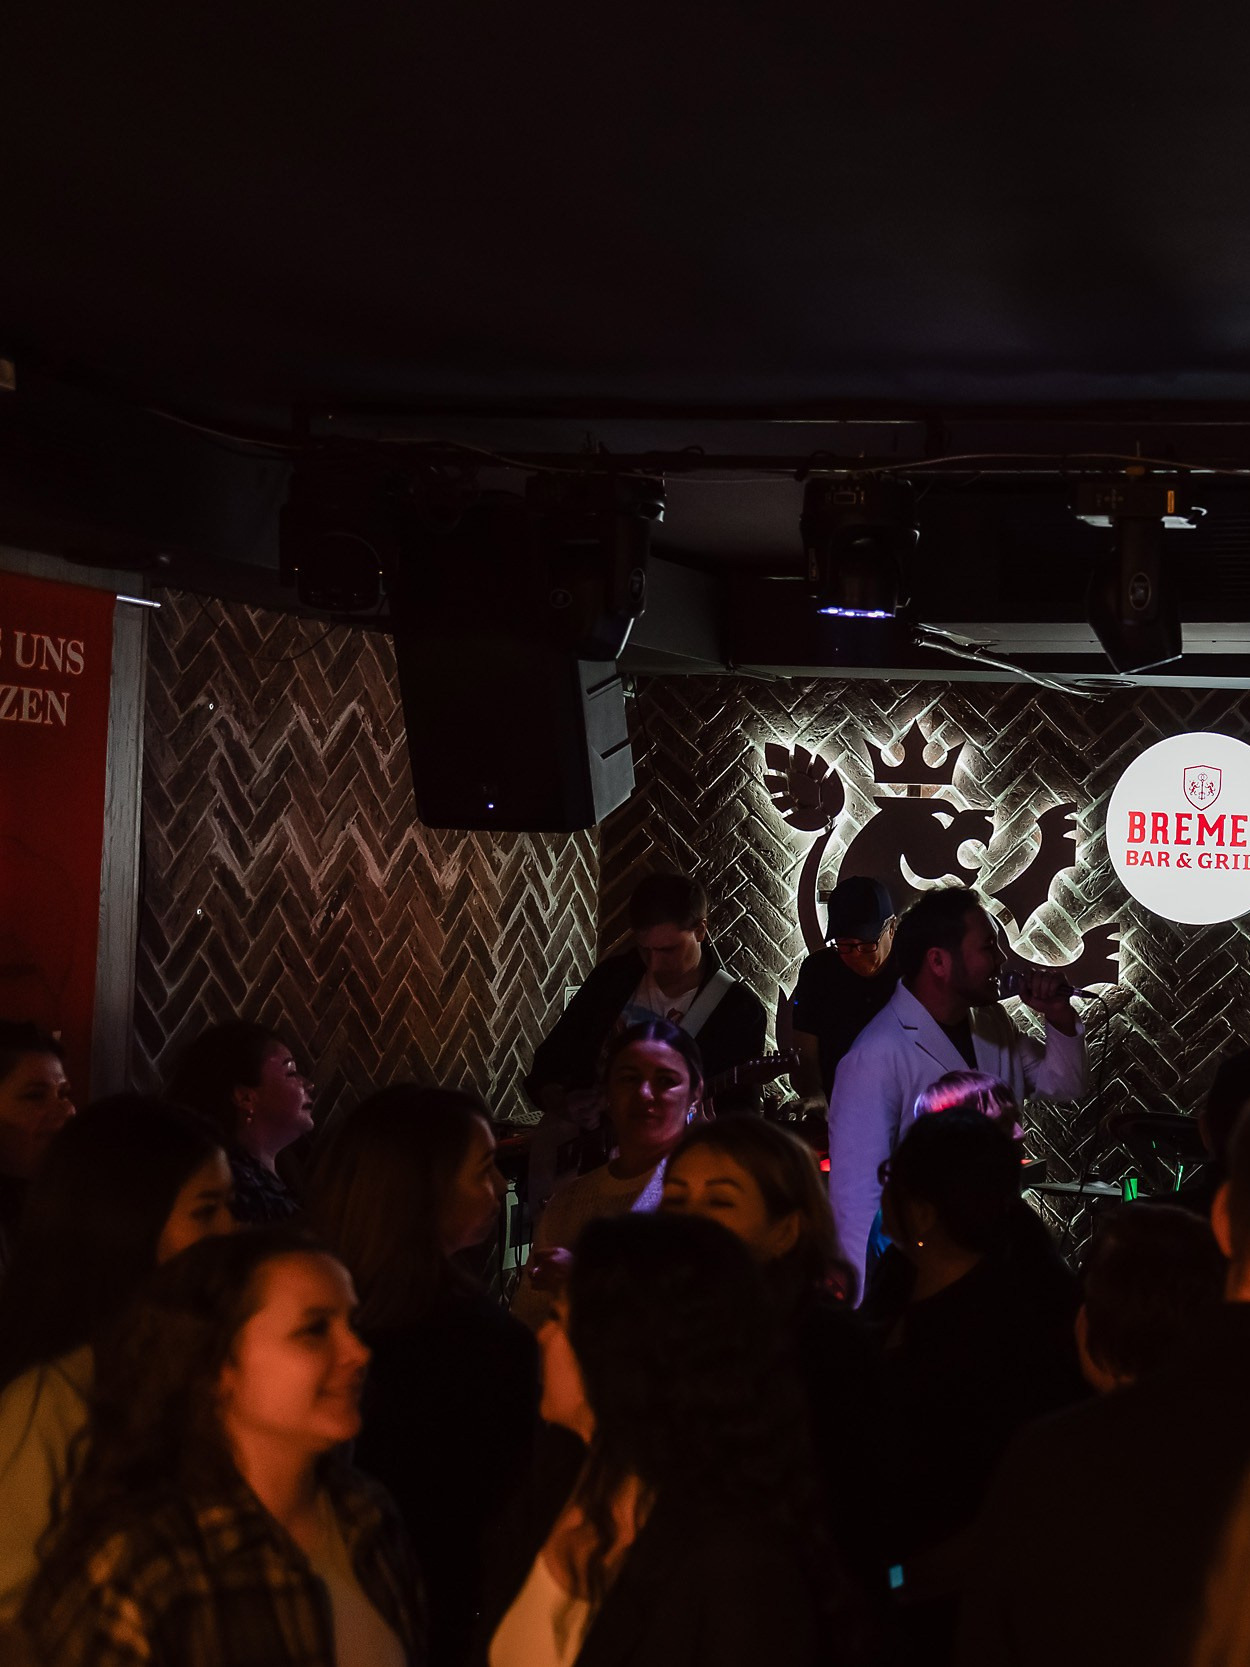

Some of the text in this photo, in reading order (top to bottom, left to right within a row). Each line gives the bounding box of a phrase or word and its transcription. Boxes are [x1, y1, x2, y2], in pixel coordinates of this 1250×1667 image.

[14, 631, 85, 675] UNS
[0, 684, 70, 727] ZEN
[1125, 850, 1170, 868] BAR
[1176, 852, 1192, 869] &
